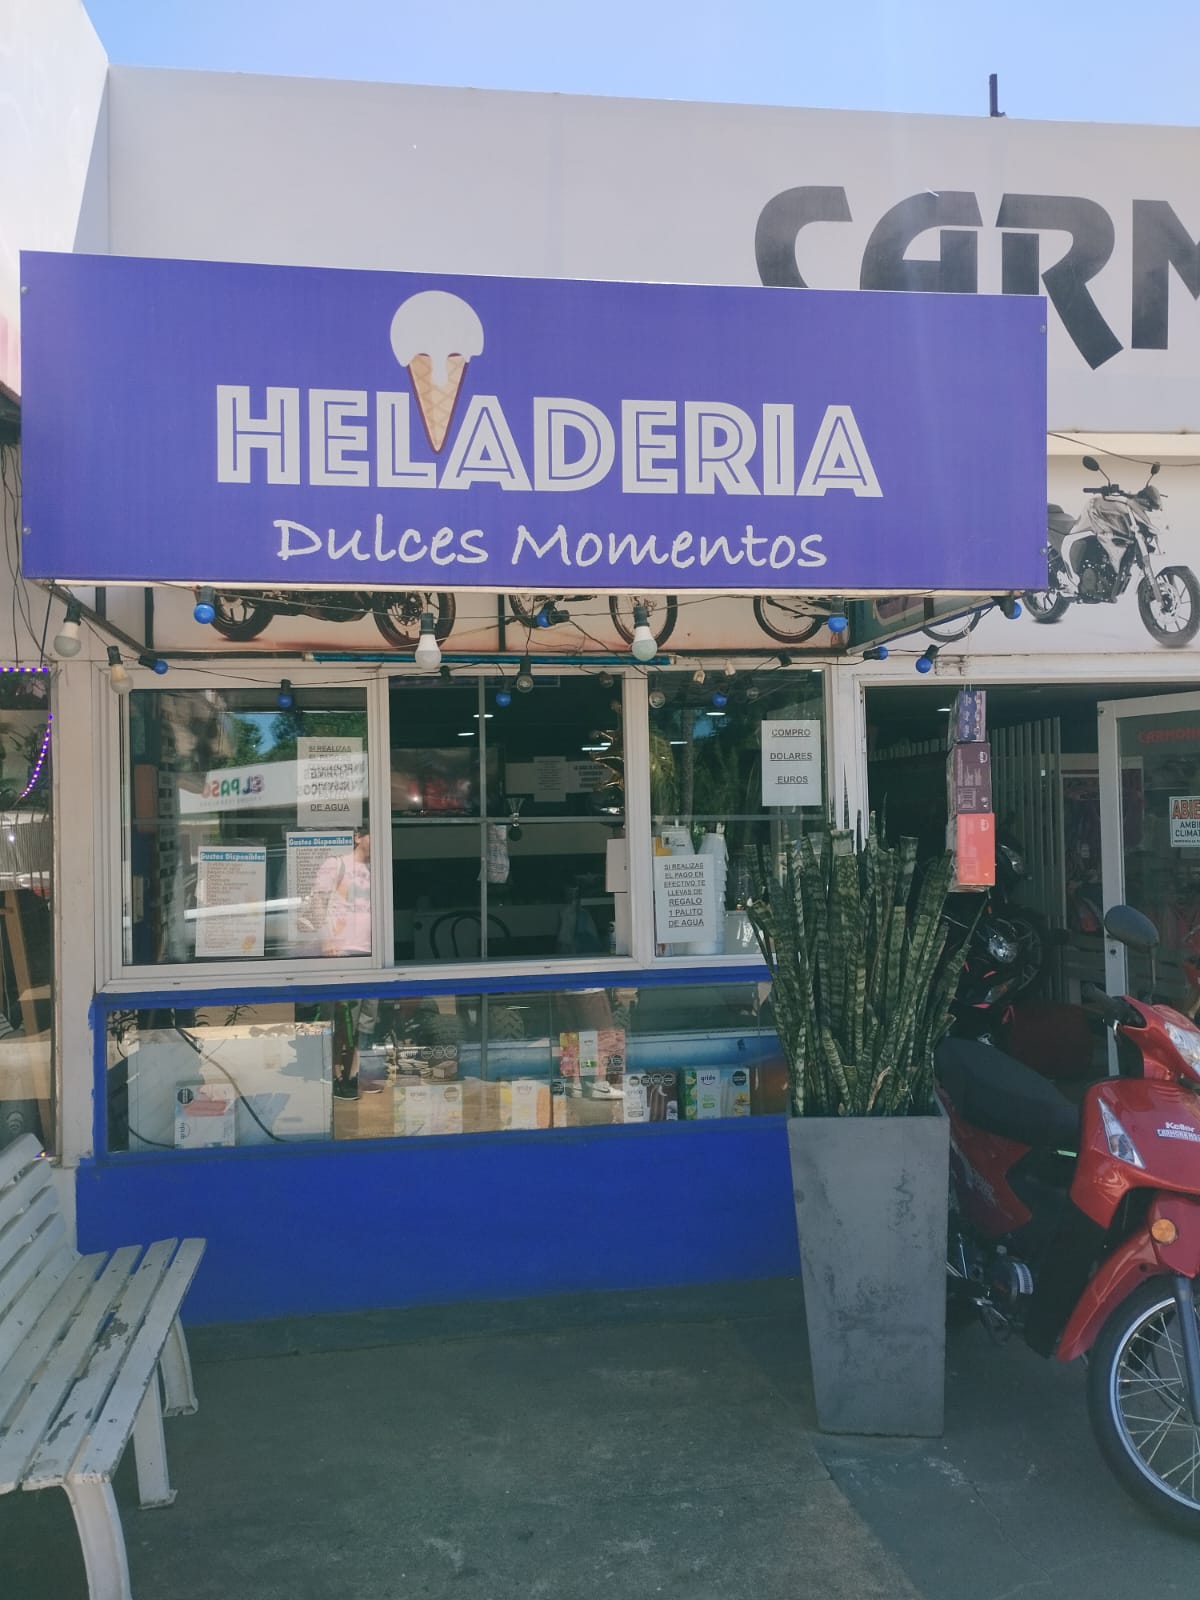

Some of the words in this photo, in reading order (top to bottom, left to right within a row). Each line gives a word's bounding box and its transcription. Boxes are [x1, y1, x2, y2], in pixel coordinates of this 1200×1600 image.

[216, 384, 884, 498] HELADERIA
[273, 514, 488, 564] Dulces
[512, 524, 828, 568] Momentos
[771, 728, 811, 737] COMPRO
[770, 752, 813, 761] DOLARES
[776, 775, 809, 784] EUROS
[324, 803, 350, 811] AGUA
[289, 838, 312, 846] Gustos
[313, 836, 353, 847] Disponibles
[201, 852, 224, 860] Gustos
[226, 852, 265, 861] Disponibles
[672, 862, 704, 870] REALIZAS
[694, 871, 703, 879] EN
[664, 880, 696, 888] EFECTIVO
[667, 889, 692, 897] LLEVAS
[693, 888, 703, 896] DE
[669, 897, 702, 906] REGALO
[675, 908, 703, 917] PALITO
[669, 920, 680, 928] DE
[681, 918, 704, 927] AGUA
